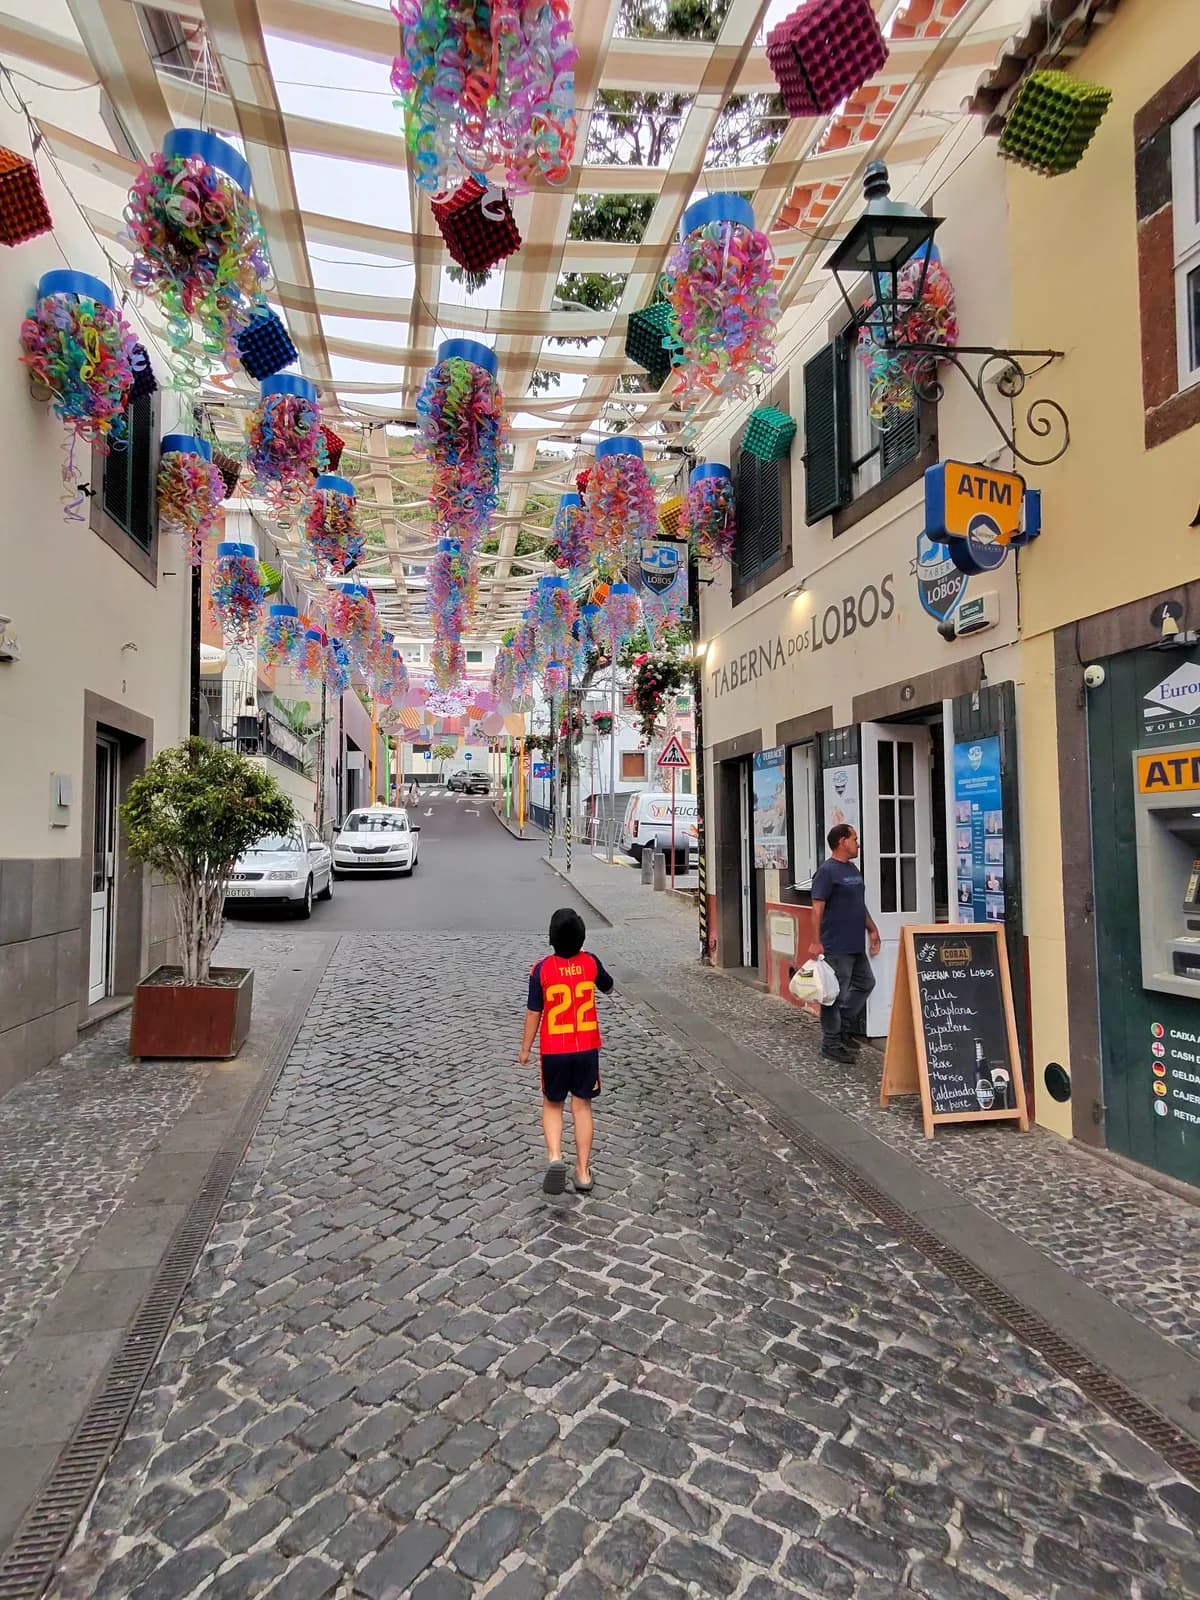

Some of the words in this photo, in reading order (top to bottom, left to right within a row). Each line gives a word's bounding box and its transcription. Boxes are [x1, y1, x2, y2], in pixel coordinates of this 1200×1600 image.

[957, 473, 1012, 506] ATM
[647, 575, 672, 585] LOBOS
[927, 577, 961, 605] LOBOS
[711, 636, 786, 698] TABERNA
[787, 630, 809, 657] DOS
[810, 573, 895, 652] LOBOS
[1160, 682, 1200, 700] Euro
[1144, 718, 1196, 732] WORLD
[944, 950, 969, 959] CORAL
[558, 963, 583, 977] THÉO
[917, 970, 949, 982] TABERNA
[952, 970, 966, 979] DOS
[970, 968, 995, 978] LOBOS
[920, 987, 958, 1002] Paella
[546, 980, 597, 1035] 22
[924, 1001, 978, 1023] Cataplana
[1170, 1029, 1197, 1043] CAIXA
[1171, 1049, 1195, 1063] CASH
